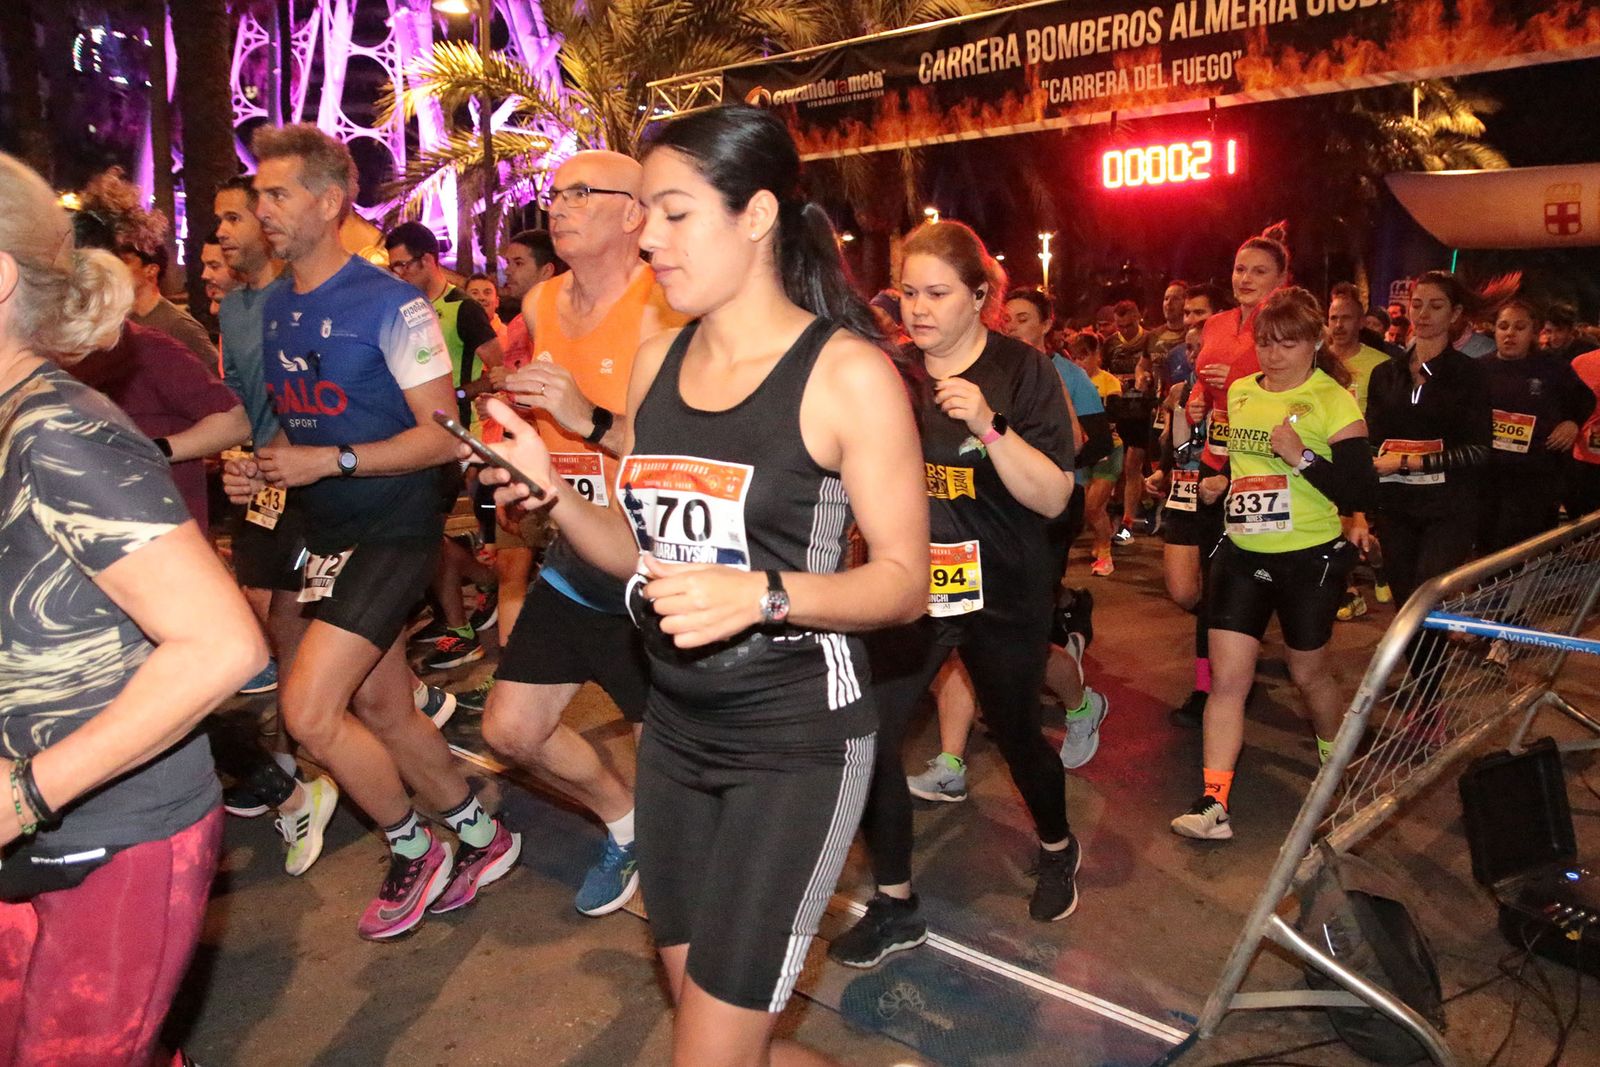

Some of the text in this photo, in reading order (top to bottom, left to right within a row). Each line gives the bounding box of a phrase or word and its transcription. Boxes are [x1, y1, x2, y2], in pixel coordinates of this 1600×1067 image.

[918, 33, 1022, 85] CARRERA
[1026, 6, 1164, 65] BOMBEROS
[1134, 63, 1169, 92] DEL
[289, 418, 318, 429] SPORT
[1492, 421, 1524, 437] 2506
[1229, 428, 1272, 442] UNNER
[954, 470, 968, 494] TEAM
[1235, 492, 1279, 514] 337
[656, 496, 712, 542] 70
[678, 544, 718, 564] TYSON
[933, 567, 967, 587] 94
